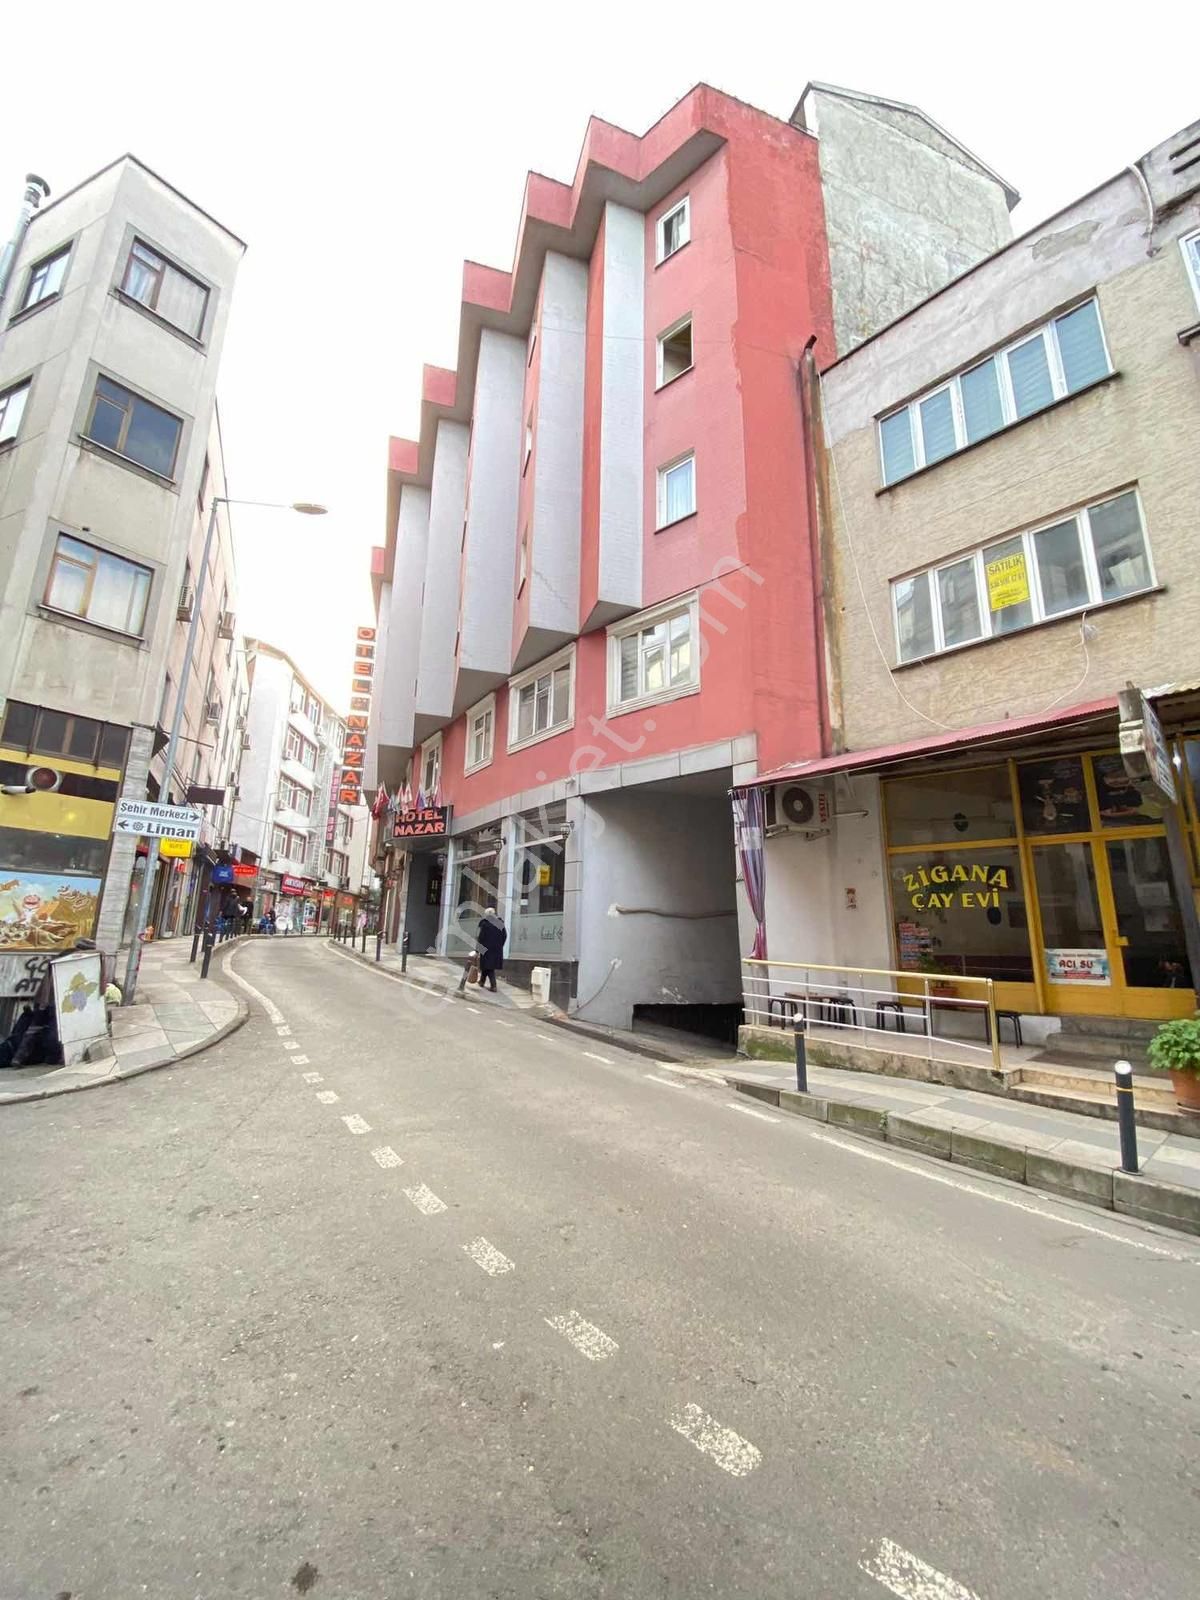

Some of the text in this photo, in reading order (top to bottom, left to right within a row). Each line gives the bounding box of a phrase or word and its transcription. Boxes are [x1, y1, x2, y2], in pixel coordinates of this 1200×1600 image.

[352, 627, 376, 692] OTEL
[340, 716, 368, 805] NAZAR
[120, 802, 189, 820] Şehir Merkezi
[395, 808, 443, 823] HOTEL
[146, 822, 195, 839] Liman
[394, 821, 445, 837] NAZAR
[902, 864, 1009, 892] ZİGANA
[911, 887, 1000, 912] ÇAY EVİ
[1079, 959, 1094, 969] SU
